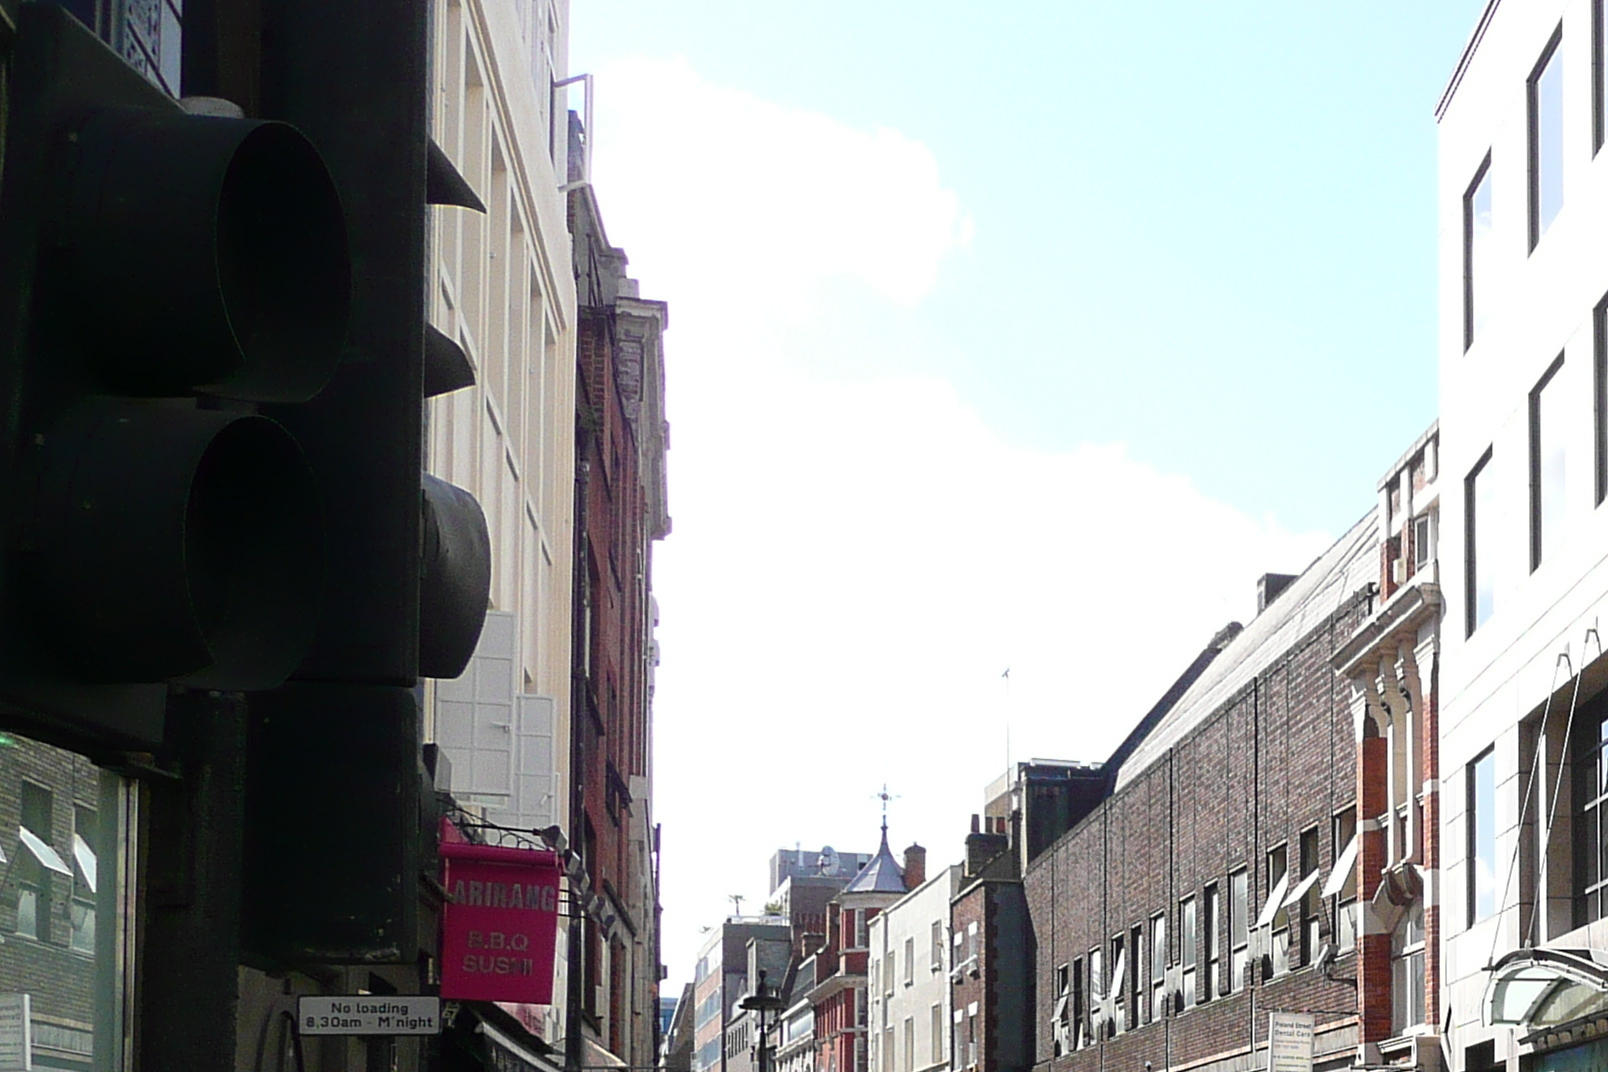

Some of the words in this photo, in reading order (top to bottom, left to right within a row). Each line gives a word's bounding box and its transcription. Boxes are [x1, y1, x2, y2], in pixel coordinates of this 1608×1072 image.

[453, 879, 556, 911] ARIRANG
[462, 955, 533, 976] SUSHI
[331, 1002, 351, 1014] No
[356, 1002, 409, 1015] loading
